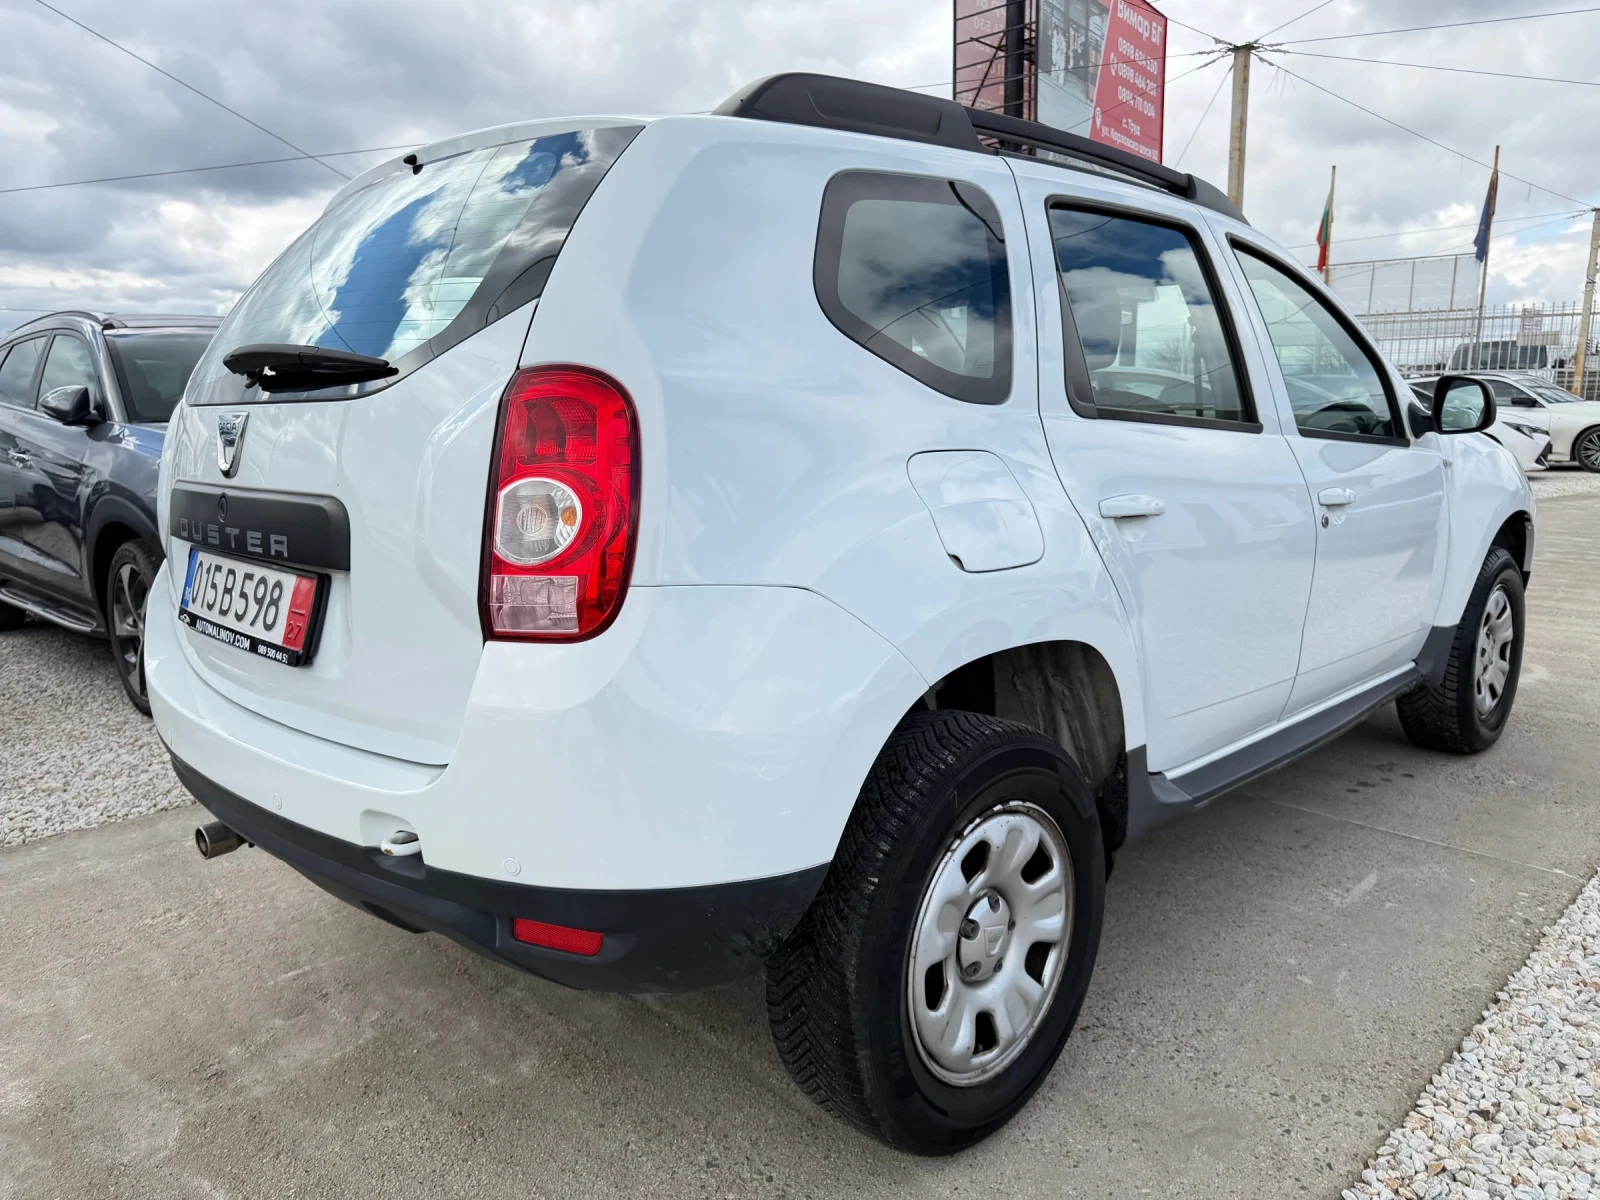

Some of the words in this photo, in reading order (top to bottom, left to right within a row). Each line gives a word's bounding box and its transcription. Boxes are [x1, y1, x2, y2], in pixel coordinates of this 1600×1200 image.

[218, 421, 238, 433] DACIA
[180, 517, 289, 558] DUSTER
[195, 618, 251, 651] AUTOMALINOV.COM
[286, 620, 303, 641] 27
